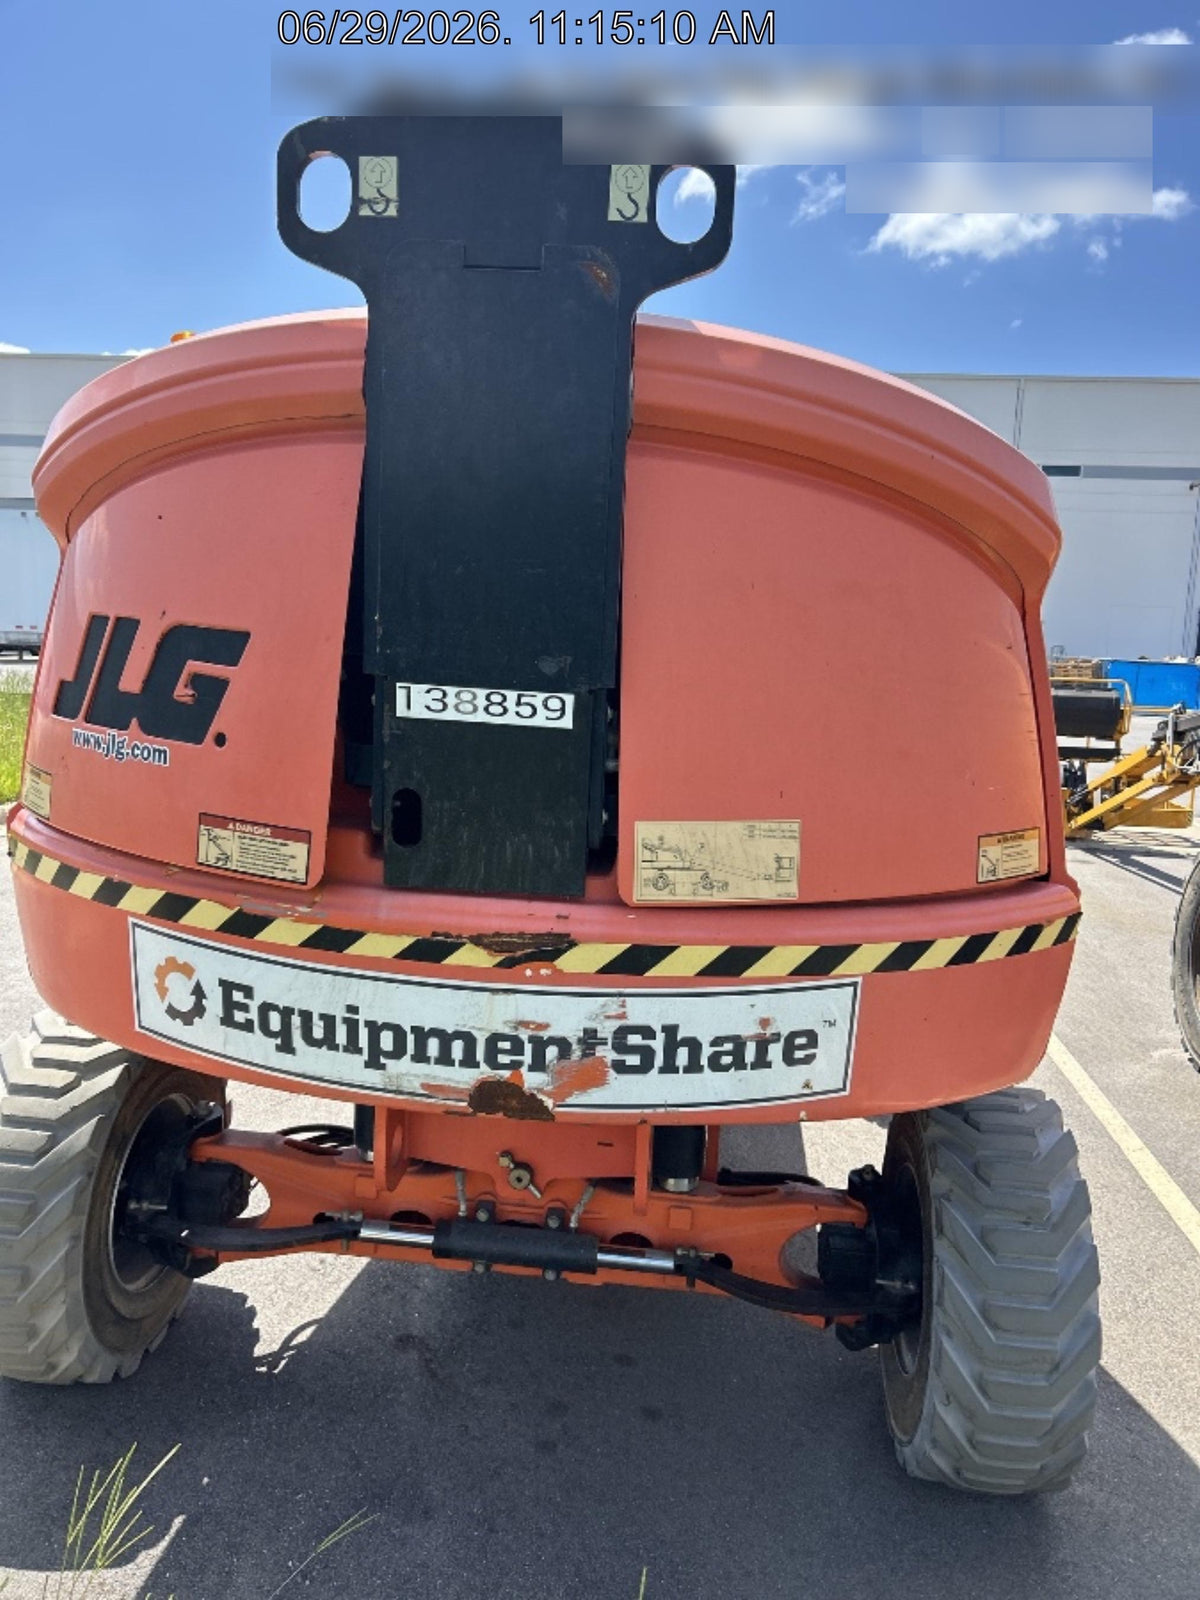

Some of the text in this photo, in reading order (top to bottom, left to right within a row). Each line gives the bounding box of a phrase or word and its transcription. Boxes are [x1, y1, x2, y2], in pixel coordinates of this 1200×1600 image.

[53, 614, 251, 745] JLG
[397, 685, 567, 721] 138859
[72, 728, 169, 766] www.jlg.com
